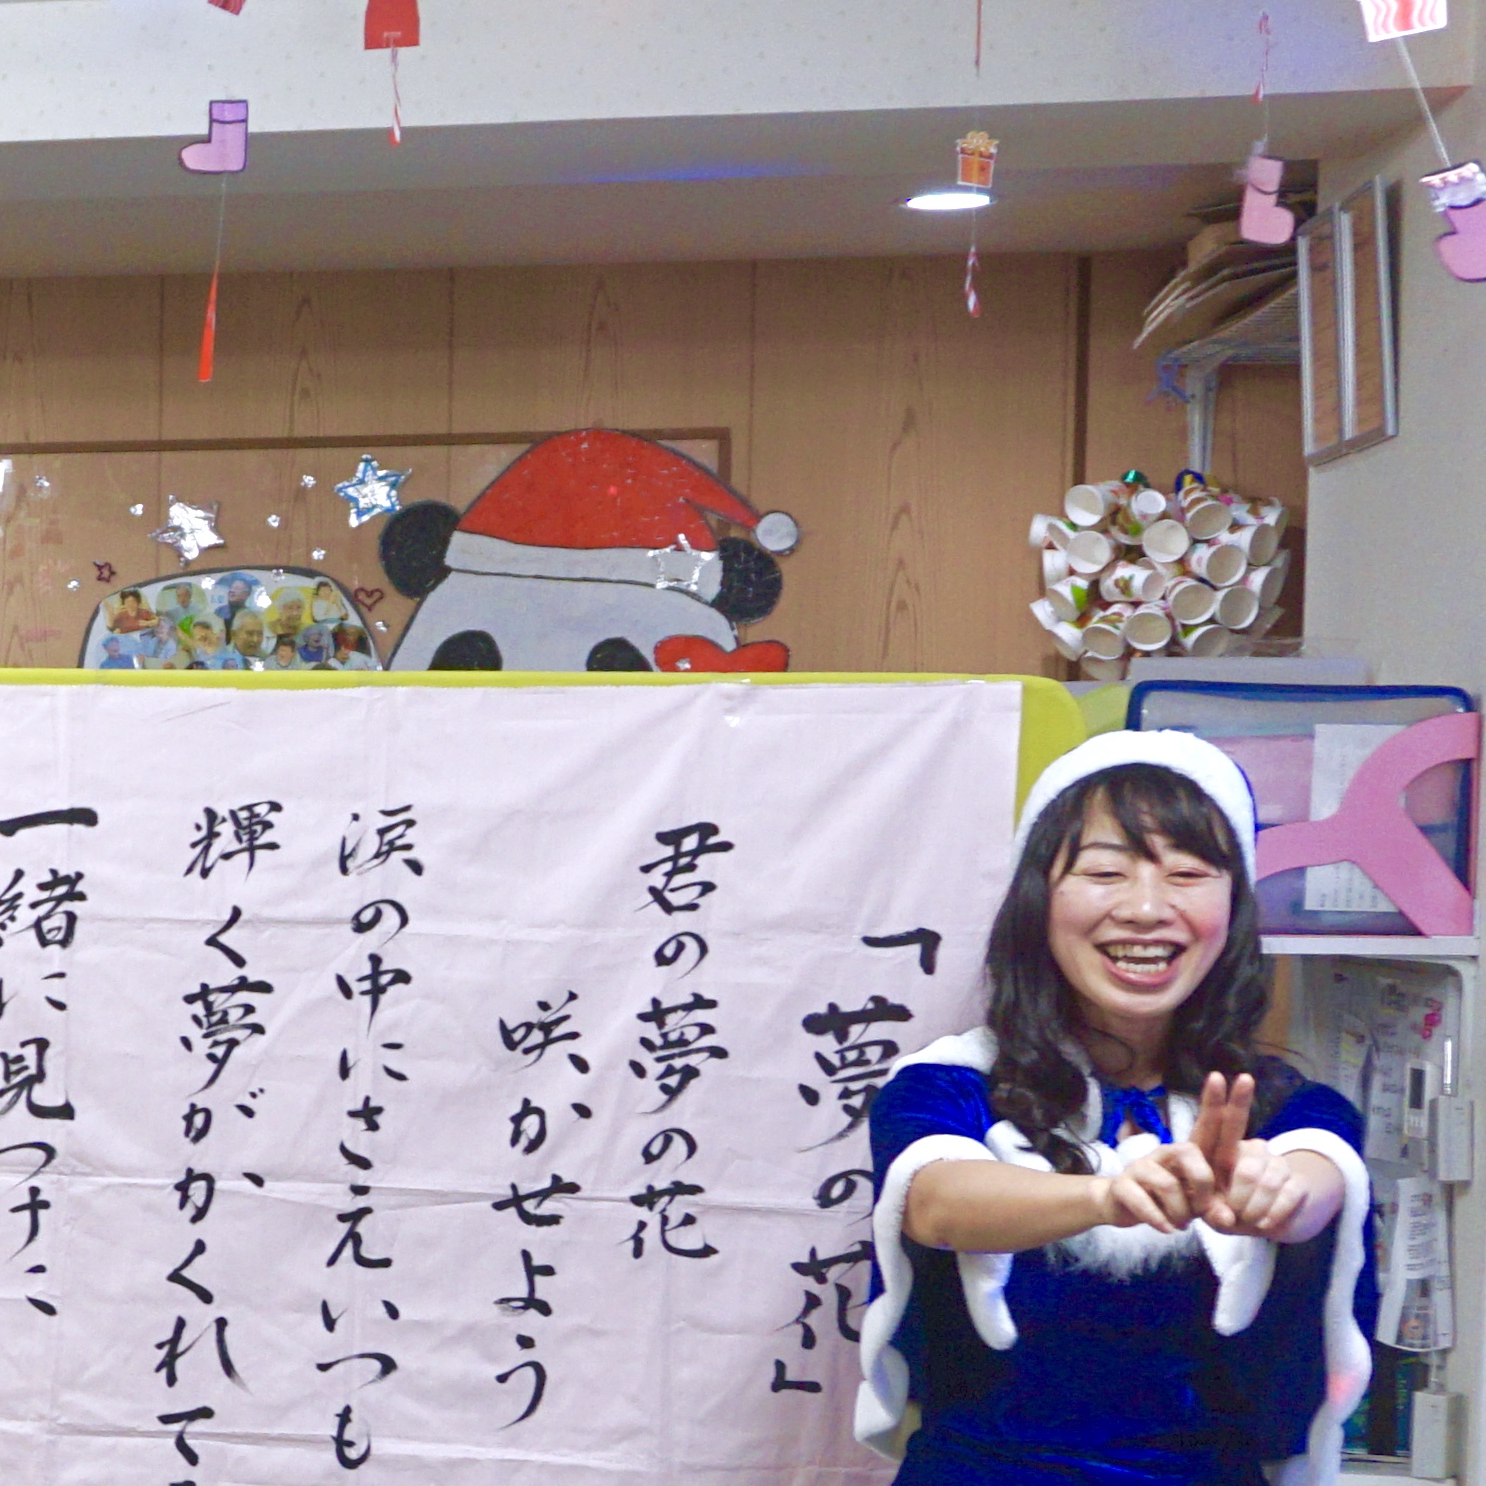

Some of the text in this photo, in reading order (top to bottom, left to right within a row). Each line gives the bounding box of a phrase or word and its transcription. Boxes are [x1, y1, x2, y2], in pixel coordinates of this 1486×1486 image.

[316, 804, 423, 1470] 涙の中にさえいつも
[492, 989, 592, 1428] 咲かせよう
[628, 821, 734, 1259] 君の夢の花
